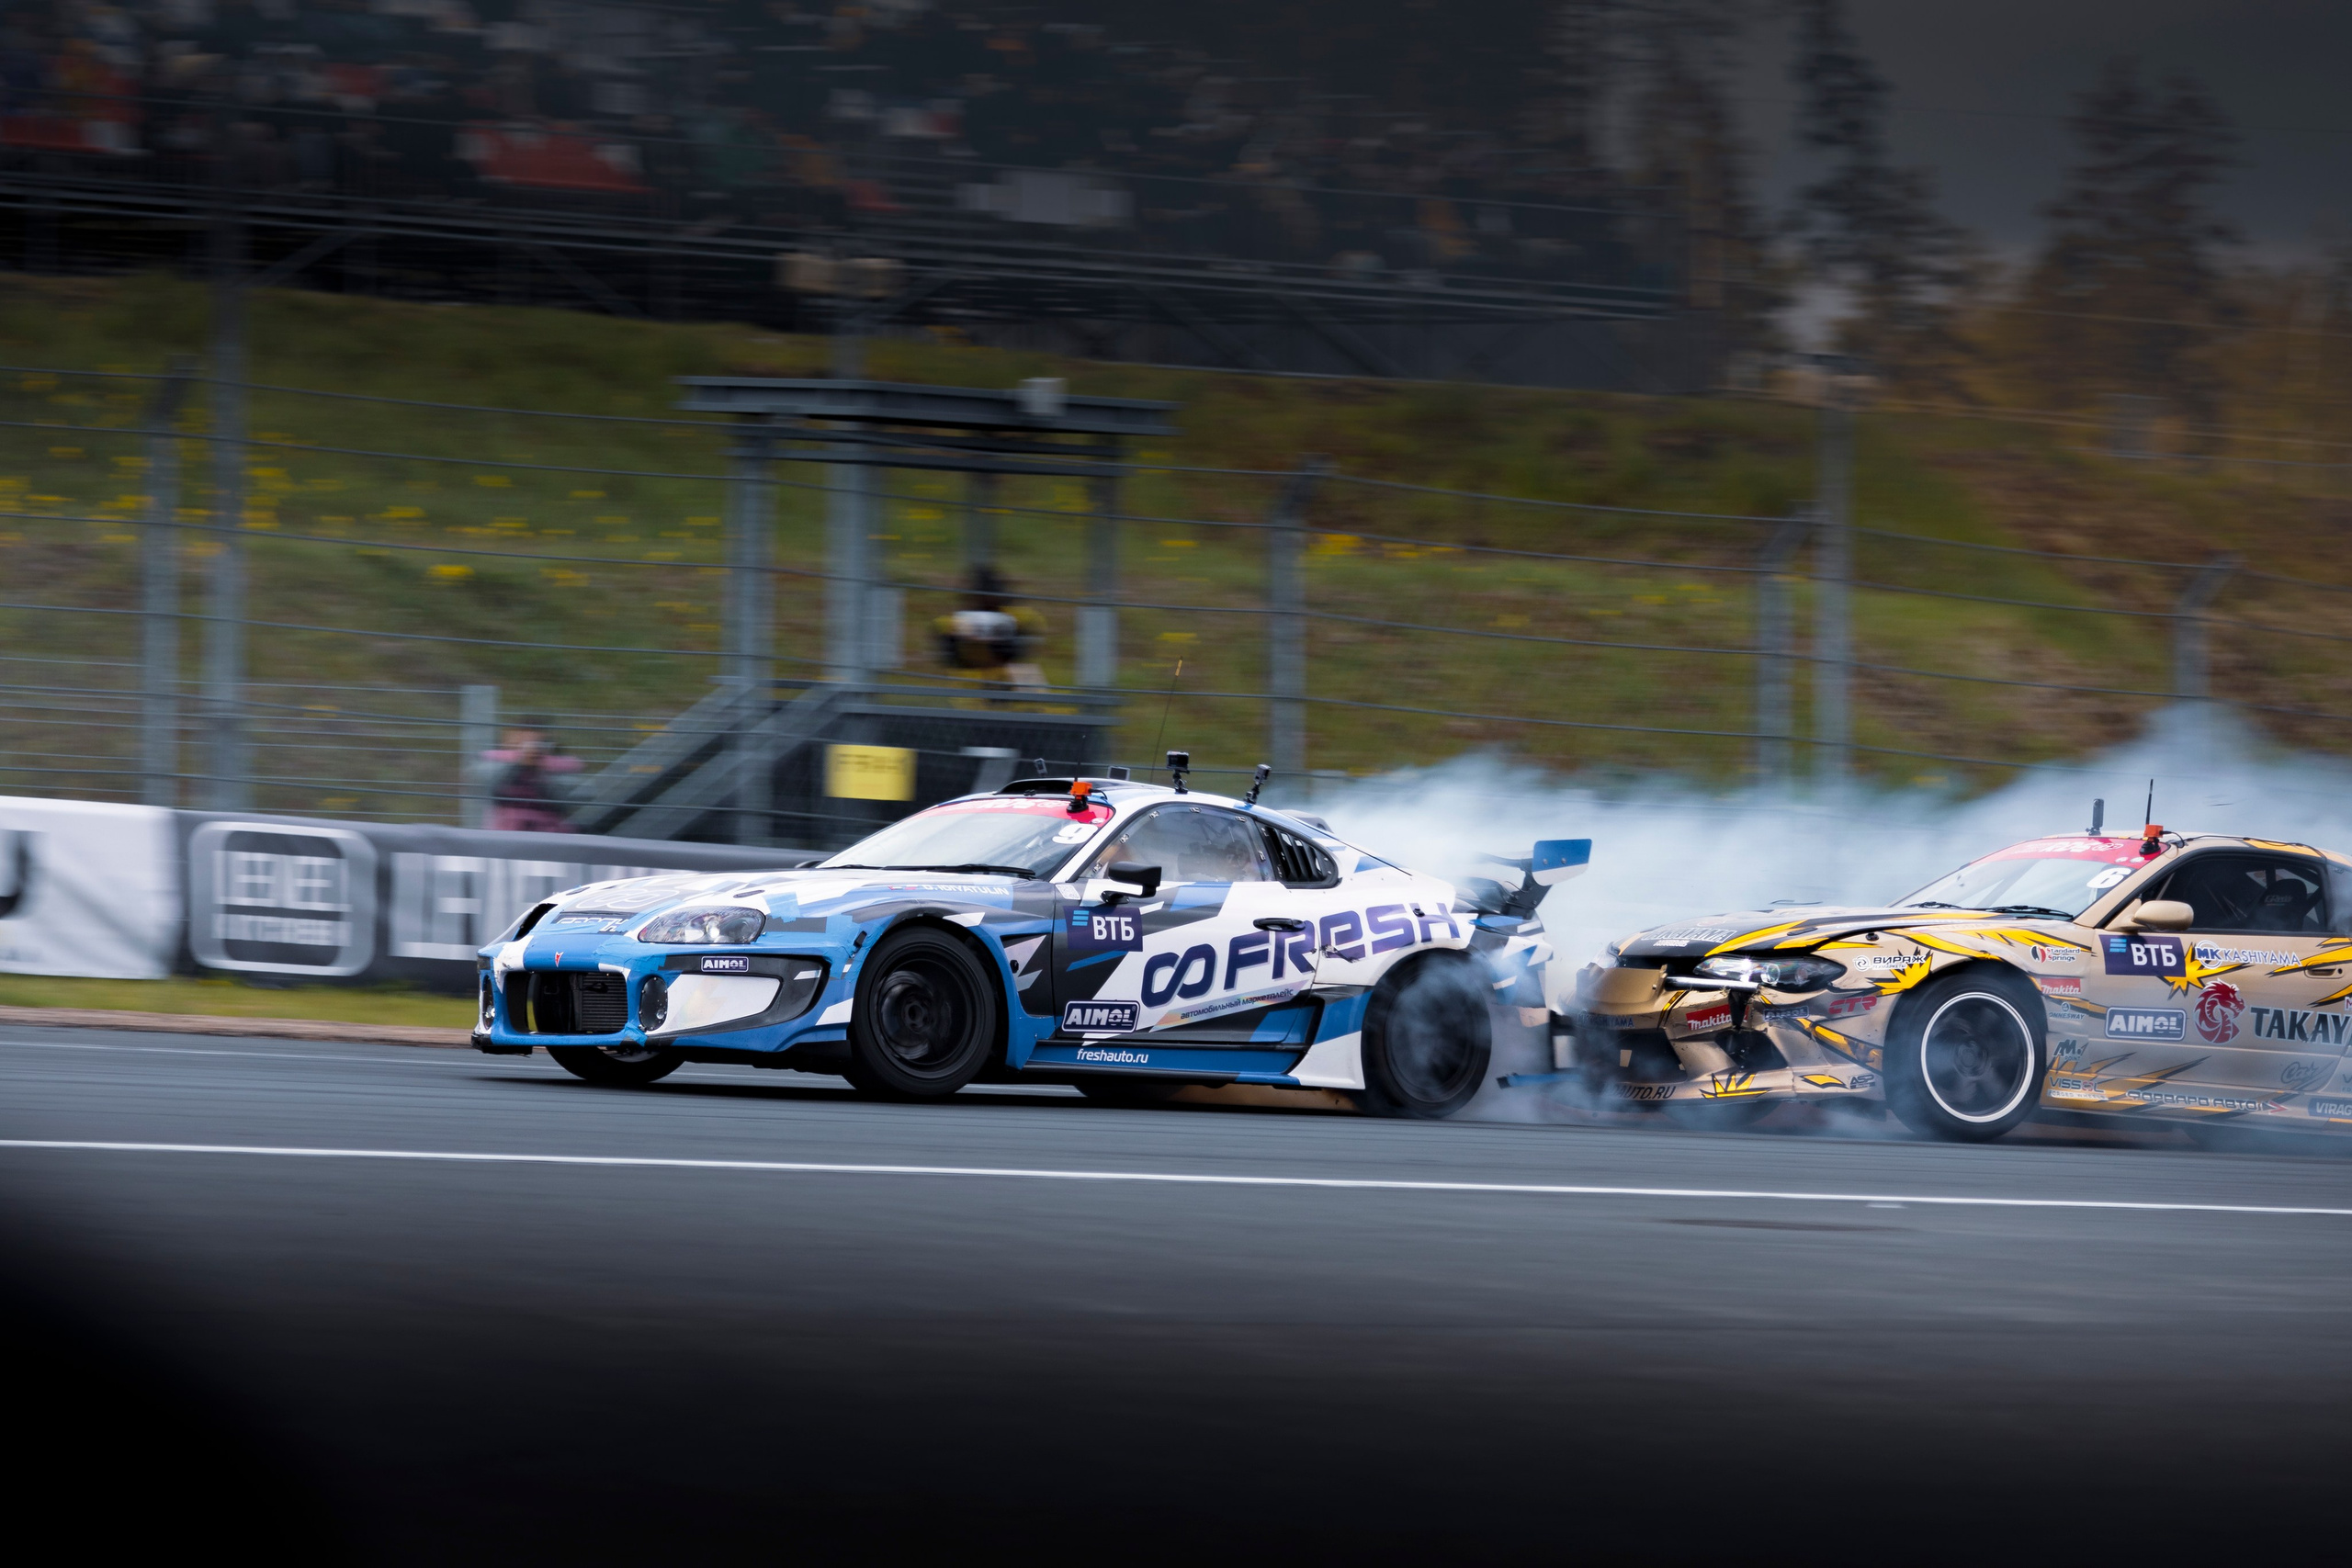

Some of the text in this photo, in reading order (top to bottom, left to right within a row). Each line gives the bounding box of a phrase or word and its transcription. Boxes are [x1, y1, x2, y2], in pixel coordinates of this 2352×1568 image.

[1052, 823, 1098, 844] 9
[2086, 867, 2132, 889] 6
[1092, 916, 1136, 942] ВТБ
[703, 958, 746, 969] AIMOL
[1872, 955, 1926, 964] ВИРАЖ
[2131, 943, 2177, 967] ВТБ
[2196, 947, 2301, 965] MK KASHIYAMA
[1180, 987, 1295, 1021] автомобильный маркетплейс
[1066, 1008, 1135, 1027] AIMOL
[2109, 1014, 2182, 1032] AIMOL
[2251, 1007, 2352, 1045] TAKAY
[1077, 1048, 1148, 1064] freshauto.ru
[1850, 1074, 1875, 1085] ASP
[2048, 1076, 2105, 1093] VISSOL
[2127, 1090, 2210, 1108] ФОРВАРД
